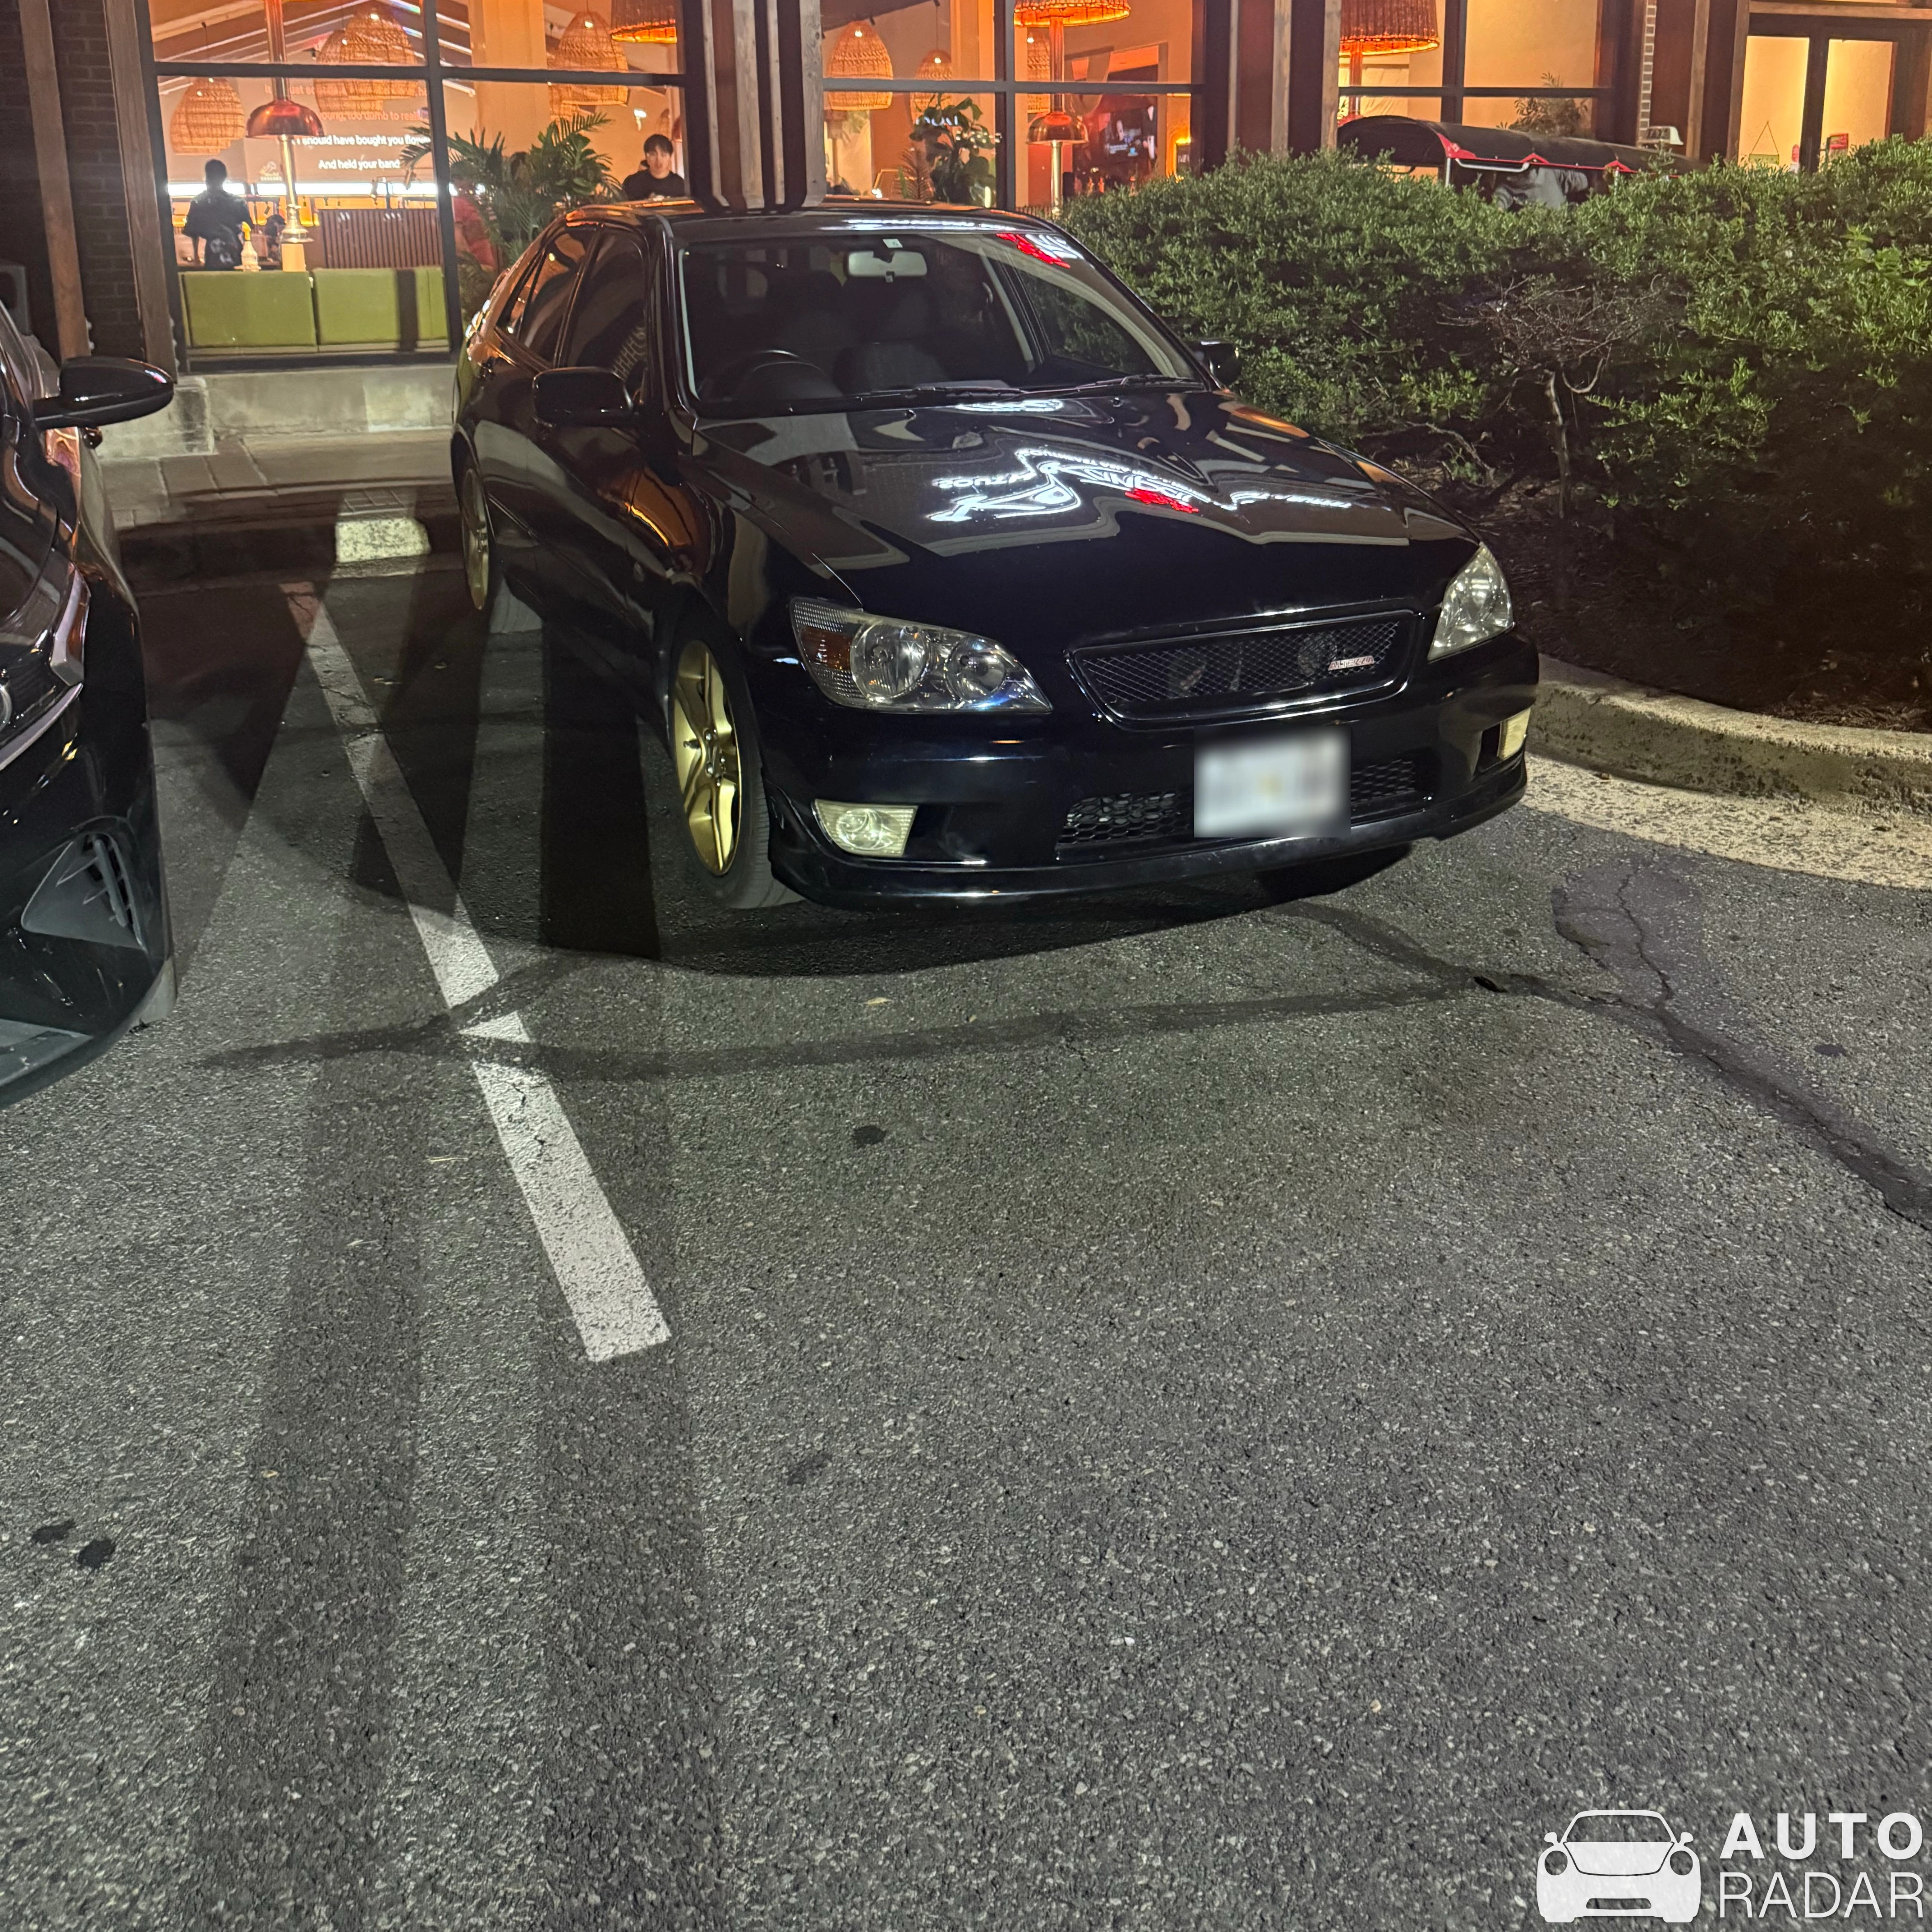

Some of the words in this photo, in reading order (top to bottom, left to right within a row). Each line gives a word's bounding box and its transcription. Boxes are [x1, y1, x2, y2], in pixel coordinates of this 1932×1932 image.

[390, 111, 400, 121] to
[333, 135, 355, 145] have
[355, 135, 387, 147] bought
[387, 136, 404, 147] you
[318, 159, 337, 169] And
[337, 159, 357, 169] held
[358, 160, 377, 171] your
